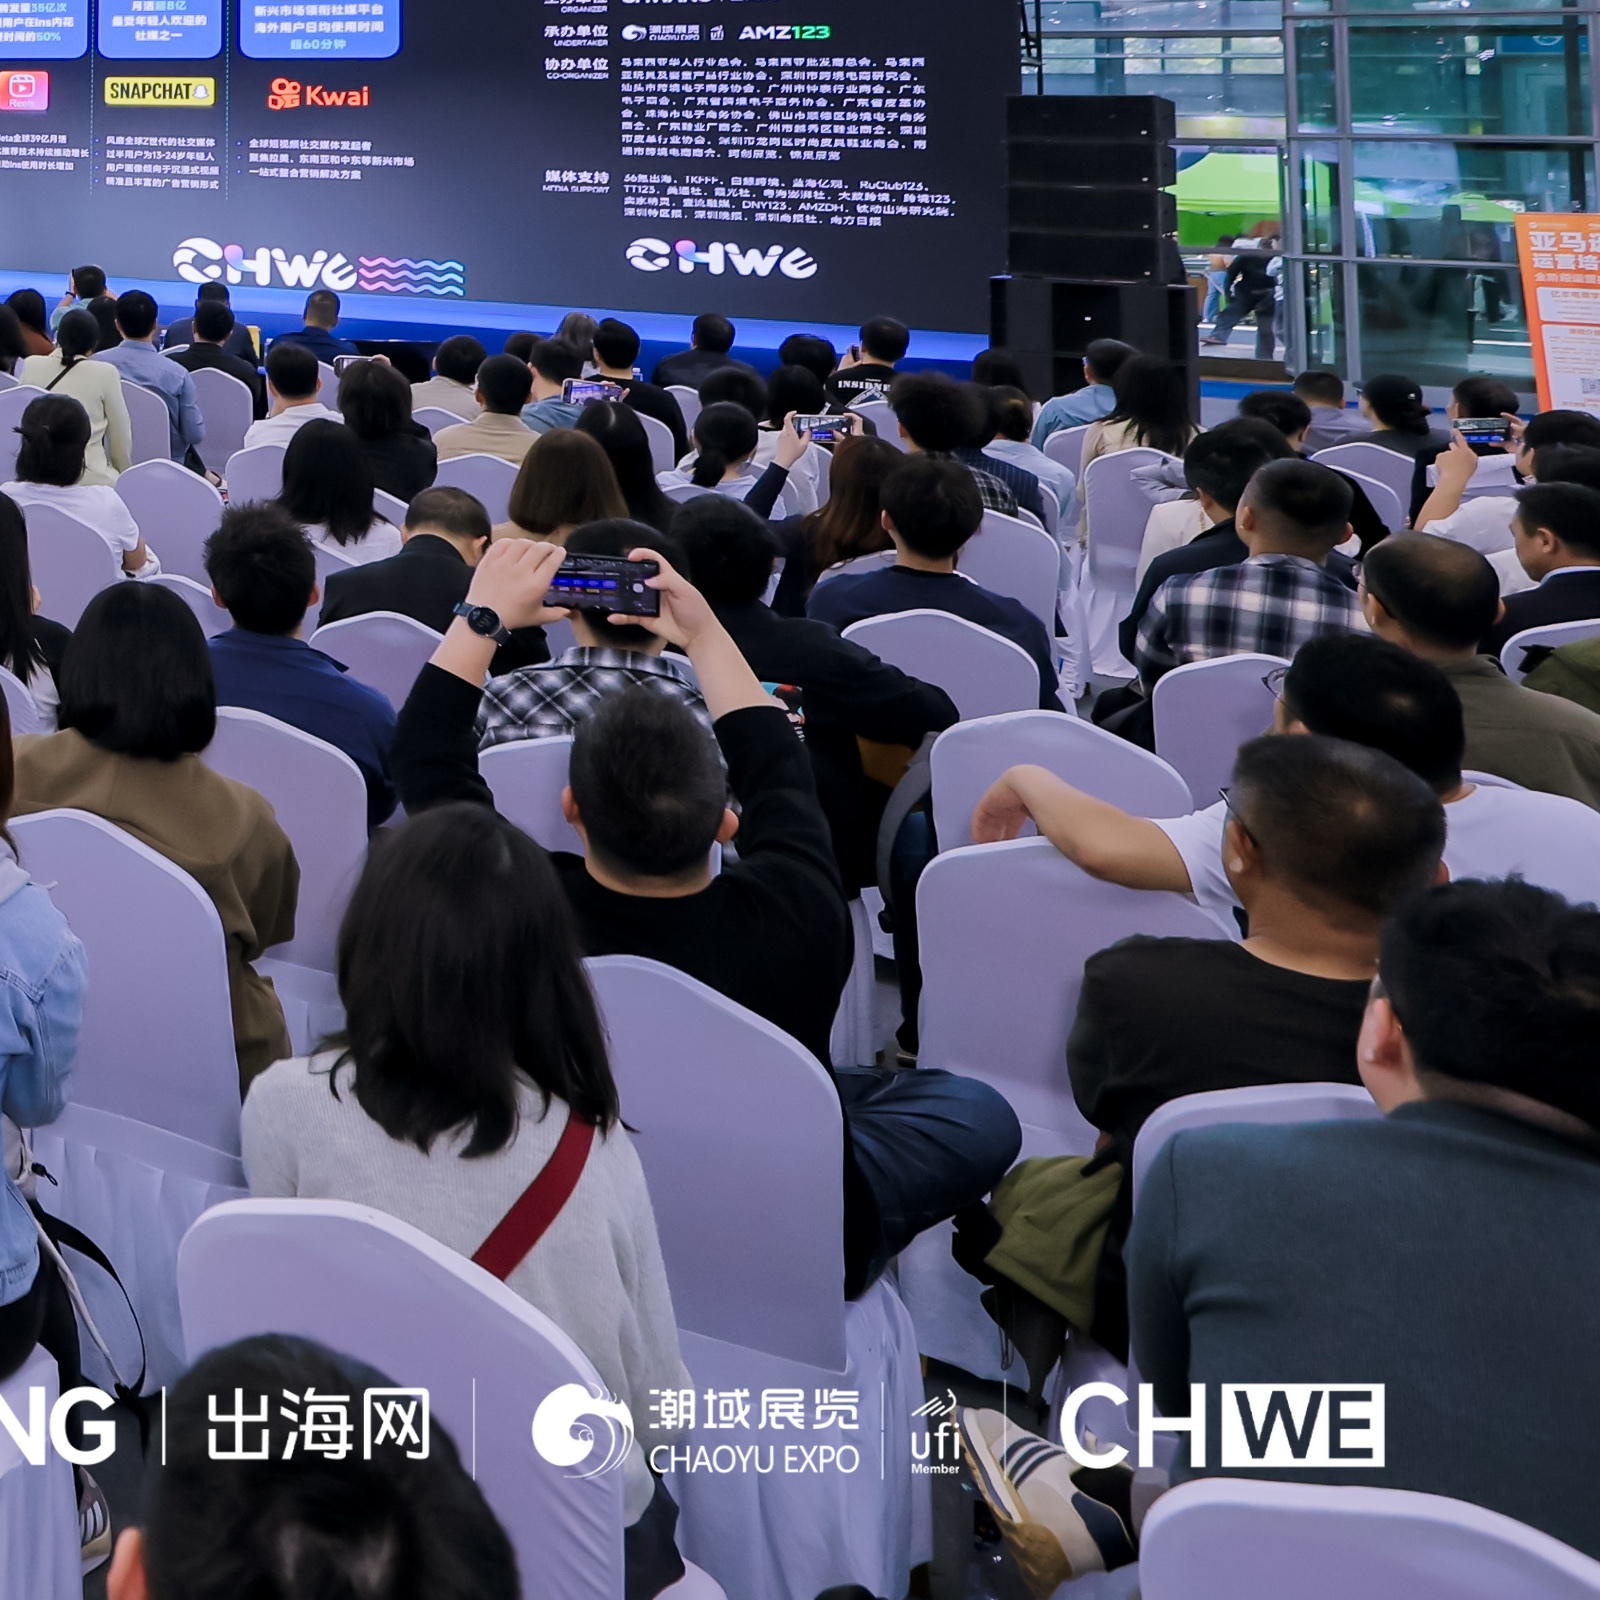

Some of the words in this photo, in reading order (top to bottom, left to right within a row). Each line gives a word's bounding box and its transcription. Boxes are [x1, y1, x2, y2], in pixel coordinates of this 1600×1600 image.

[132, 0, 187, 11] 月活超8亿
[560, 5, 608, 13] ORGANIZER
[112, 14, 207, 27] 最受年轻人欢迎的
[254, 20, 384, 33] 海外用户日均使用时间
[135, 30, 183, 42] 社媒之一
[544, 25, 608, 38] 承办单位
[738, 25, 831, 40] AMZ123
[290, 38, 347, 50] 超60分钟
[554, 39, 608, 47] UNDERTAKER
[545, 57, 609, 71] 协办单位
[546, 72, 609, 80] CO-ORGANIZER
[110, 82, 193, 100] SNAPCHAT
[306, 85, 370, 106] Kwai
[9, 98, 36, 108] Reels
[545, 170, 609, 184] 媒体支持
[571, 185, 610, 193] SUPPORT
[173, 237, 358, 291] CHWE
[625, 237, 818, 279] CHWE
